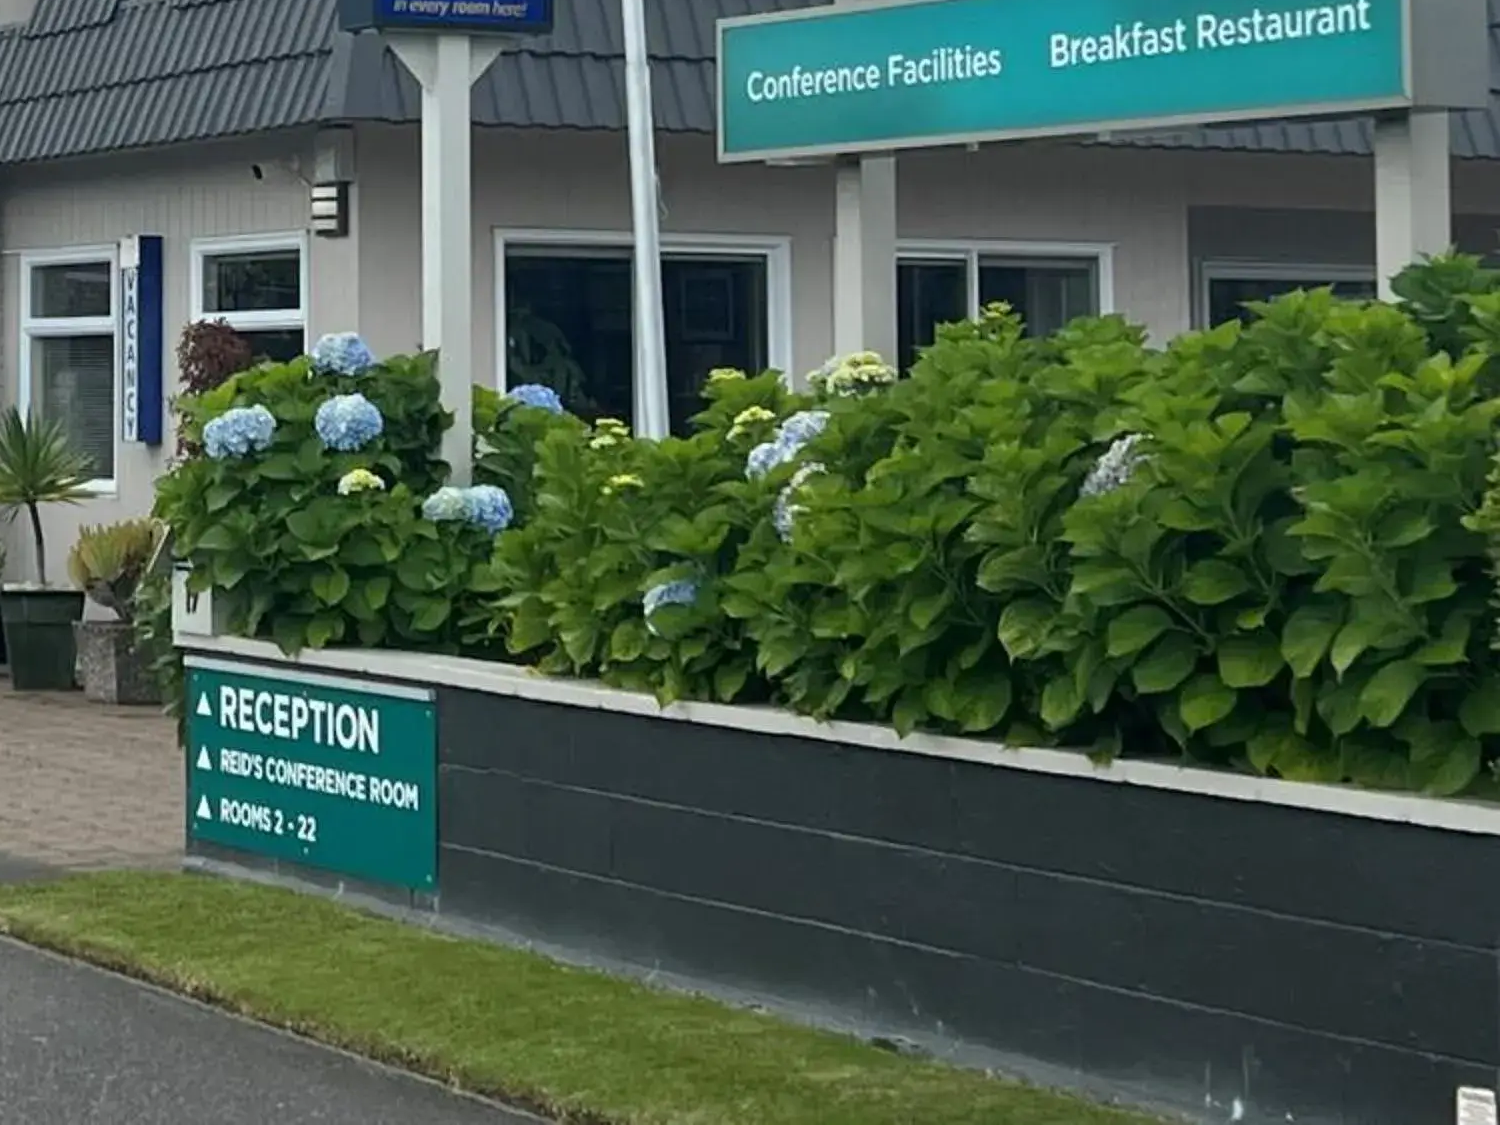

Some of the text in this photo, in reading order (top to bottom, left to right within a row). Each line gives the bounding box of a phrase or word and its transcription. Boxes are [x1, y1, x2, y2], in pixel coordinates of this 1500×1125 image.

[452, 0, 490, 15] room
[746, 65, 881, 103] Conference
[888, 47, 1002, 85] Facilities
[1050, 16, 1187, 69] Breakfast
[125, 272, 136, 438] VACANCY
[220, 686, 380, 755] RECEPTION
[220, 749, 419, 811] REID'S CONFERENCE ROOM
[220, 798, 272, 830] ROOMS
[274, 811, 283, 835] 2
[298, 816, 316, 842] 22
